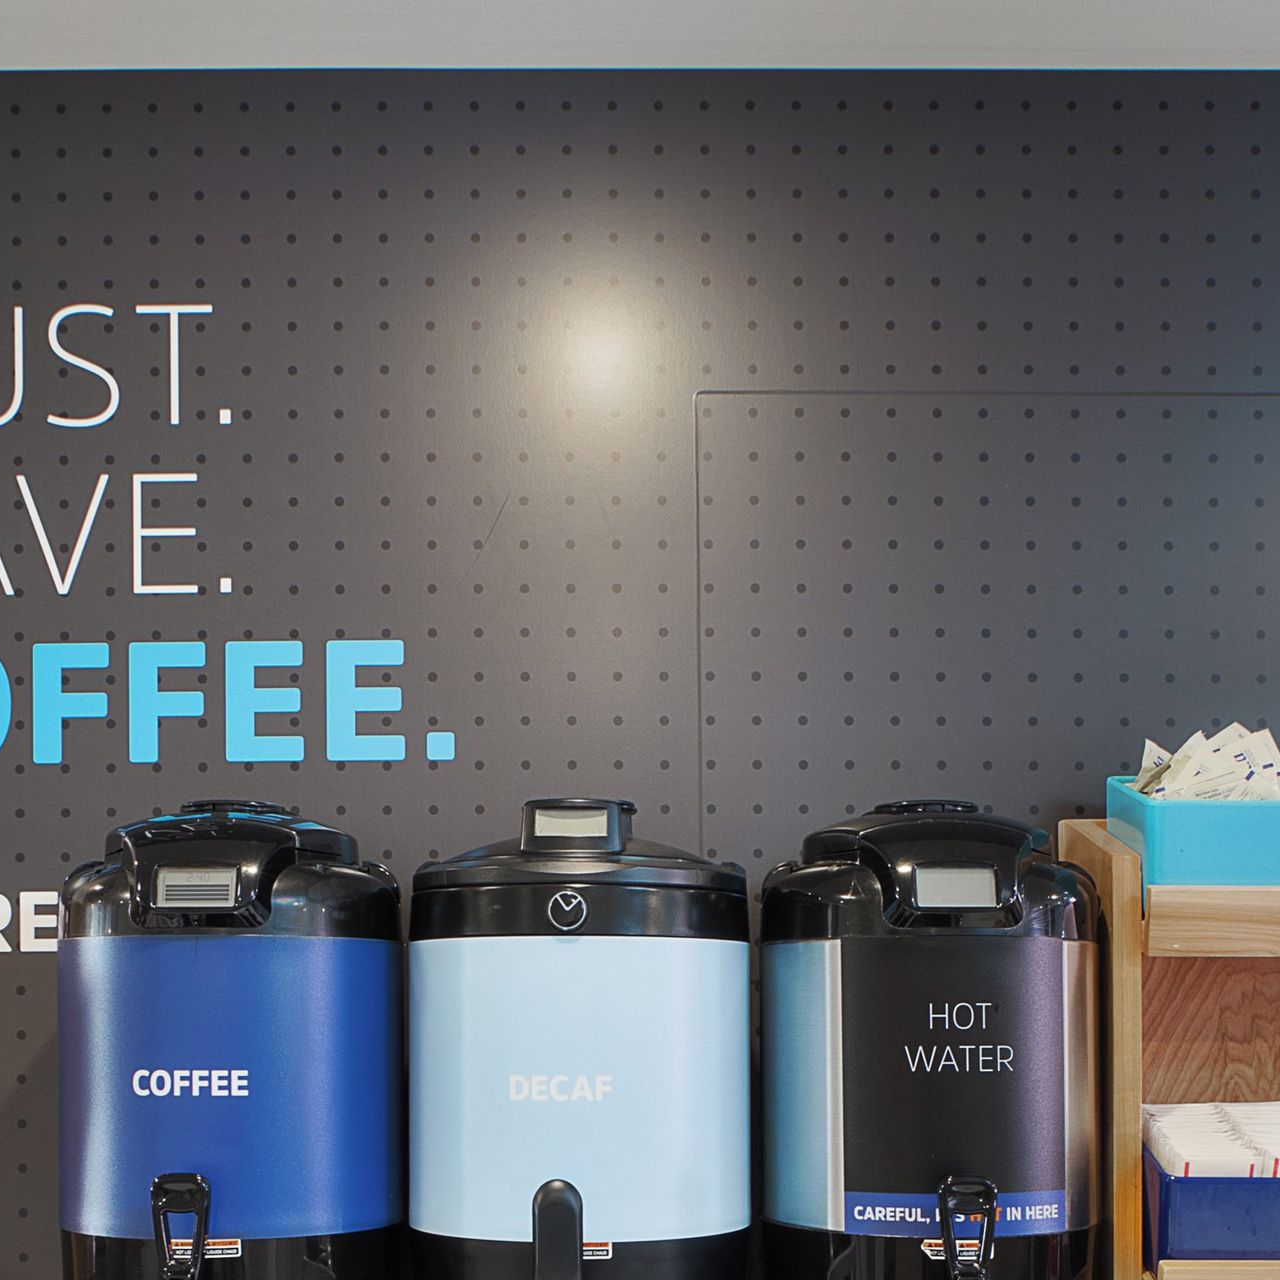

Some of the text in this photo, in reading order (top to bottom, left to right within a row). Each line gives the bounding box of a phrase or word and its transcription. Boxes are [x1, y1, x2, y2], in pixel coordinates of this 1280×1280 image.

[929, 1002, 992, 1030] HOT
[904, 1045, 1014, 1072] WATER
[132, 1069, 249, 1097] COFFEE
[509, 1075, 613, 1101] DECAF
[853, 1206, 931, 1225] CAREFUL,
[1007, 1207, 1021, 1221] IN
[1025, 1204, 1059, 1219] HERE
